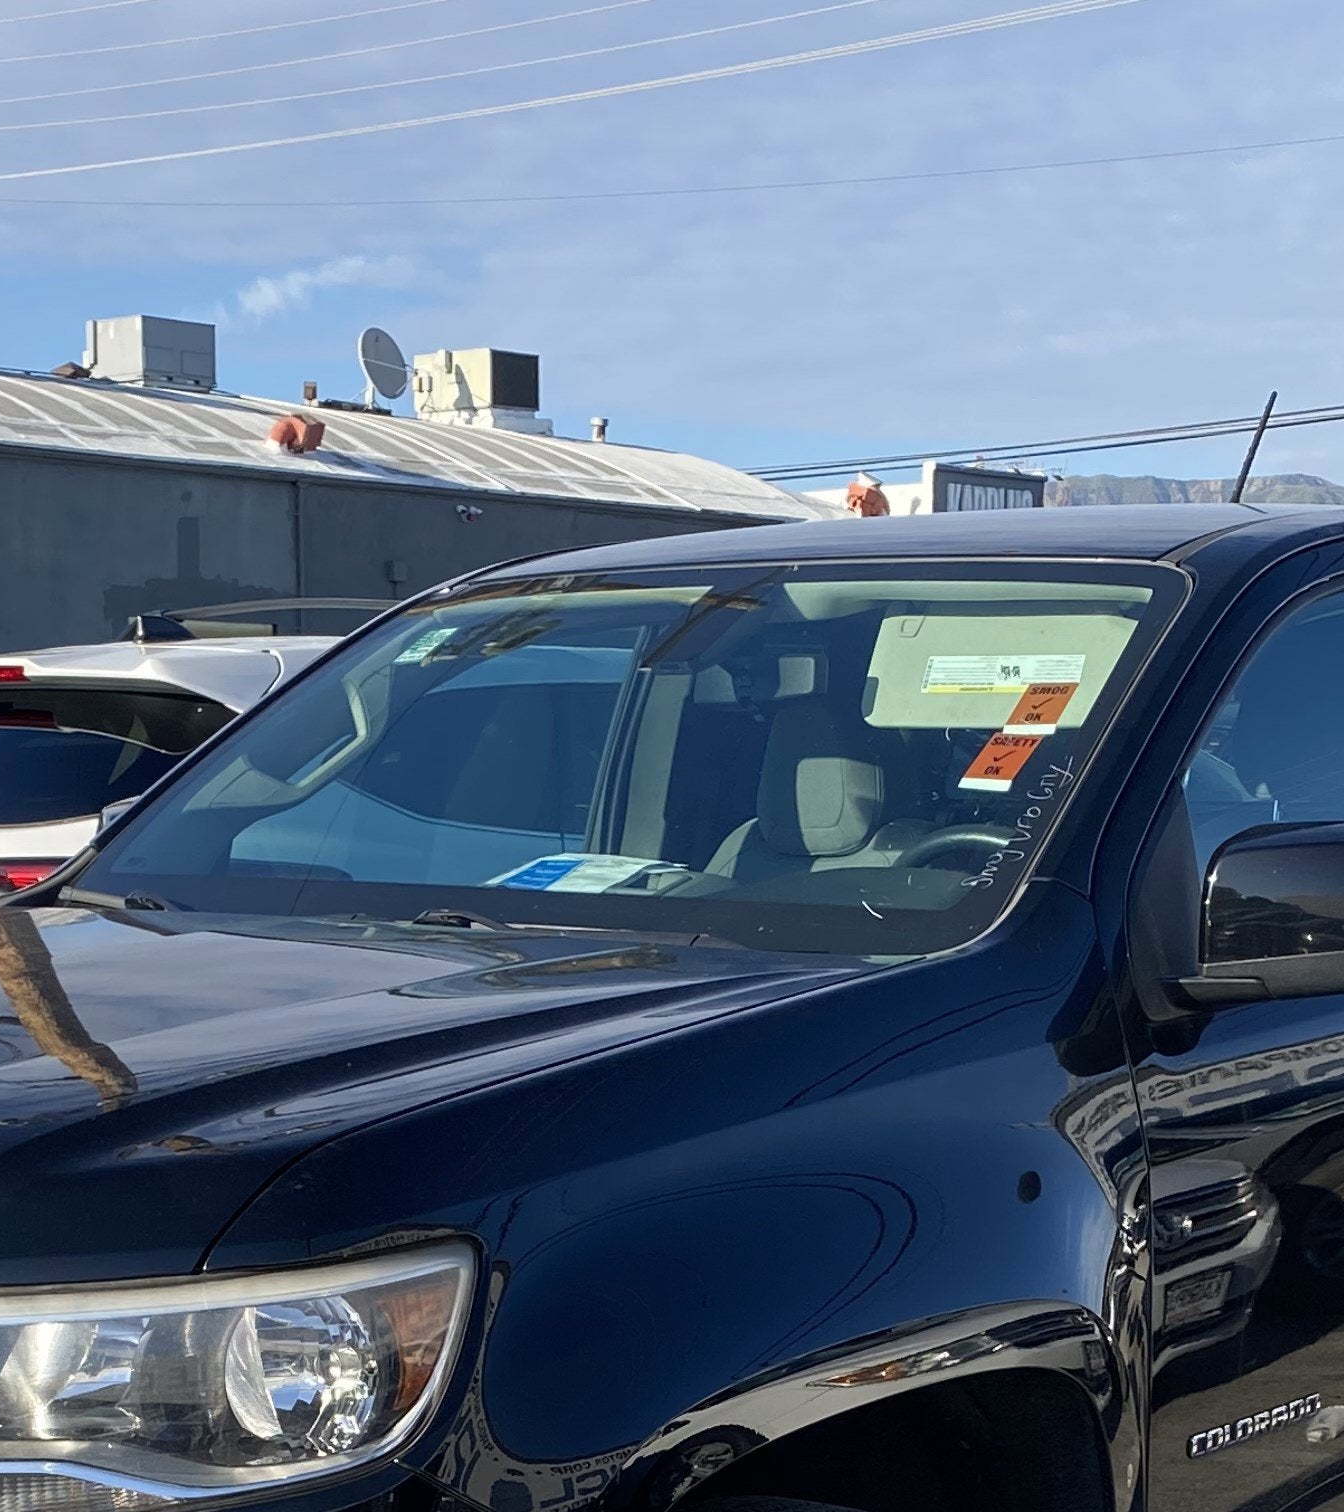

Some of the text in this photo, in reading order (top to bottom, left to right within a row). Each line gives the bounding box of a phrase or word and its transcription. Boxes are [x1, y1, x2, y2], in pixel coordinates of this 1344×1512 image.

[1030, 686, 1070, 696] SMOG
[1024, 712, 1044, 722] OK
[990, 736, 1040, 748] SAFETY
[984, 765, 1004, 776] OK
[1188, 1391, 1322, 1458] COLORADO
